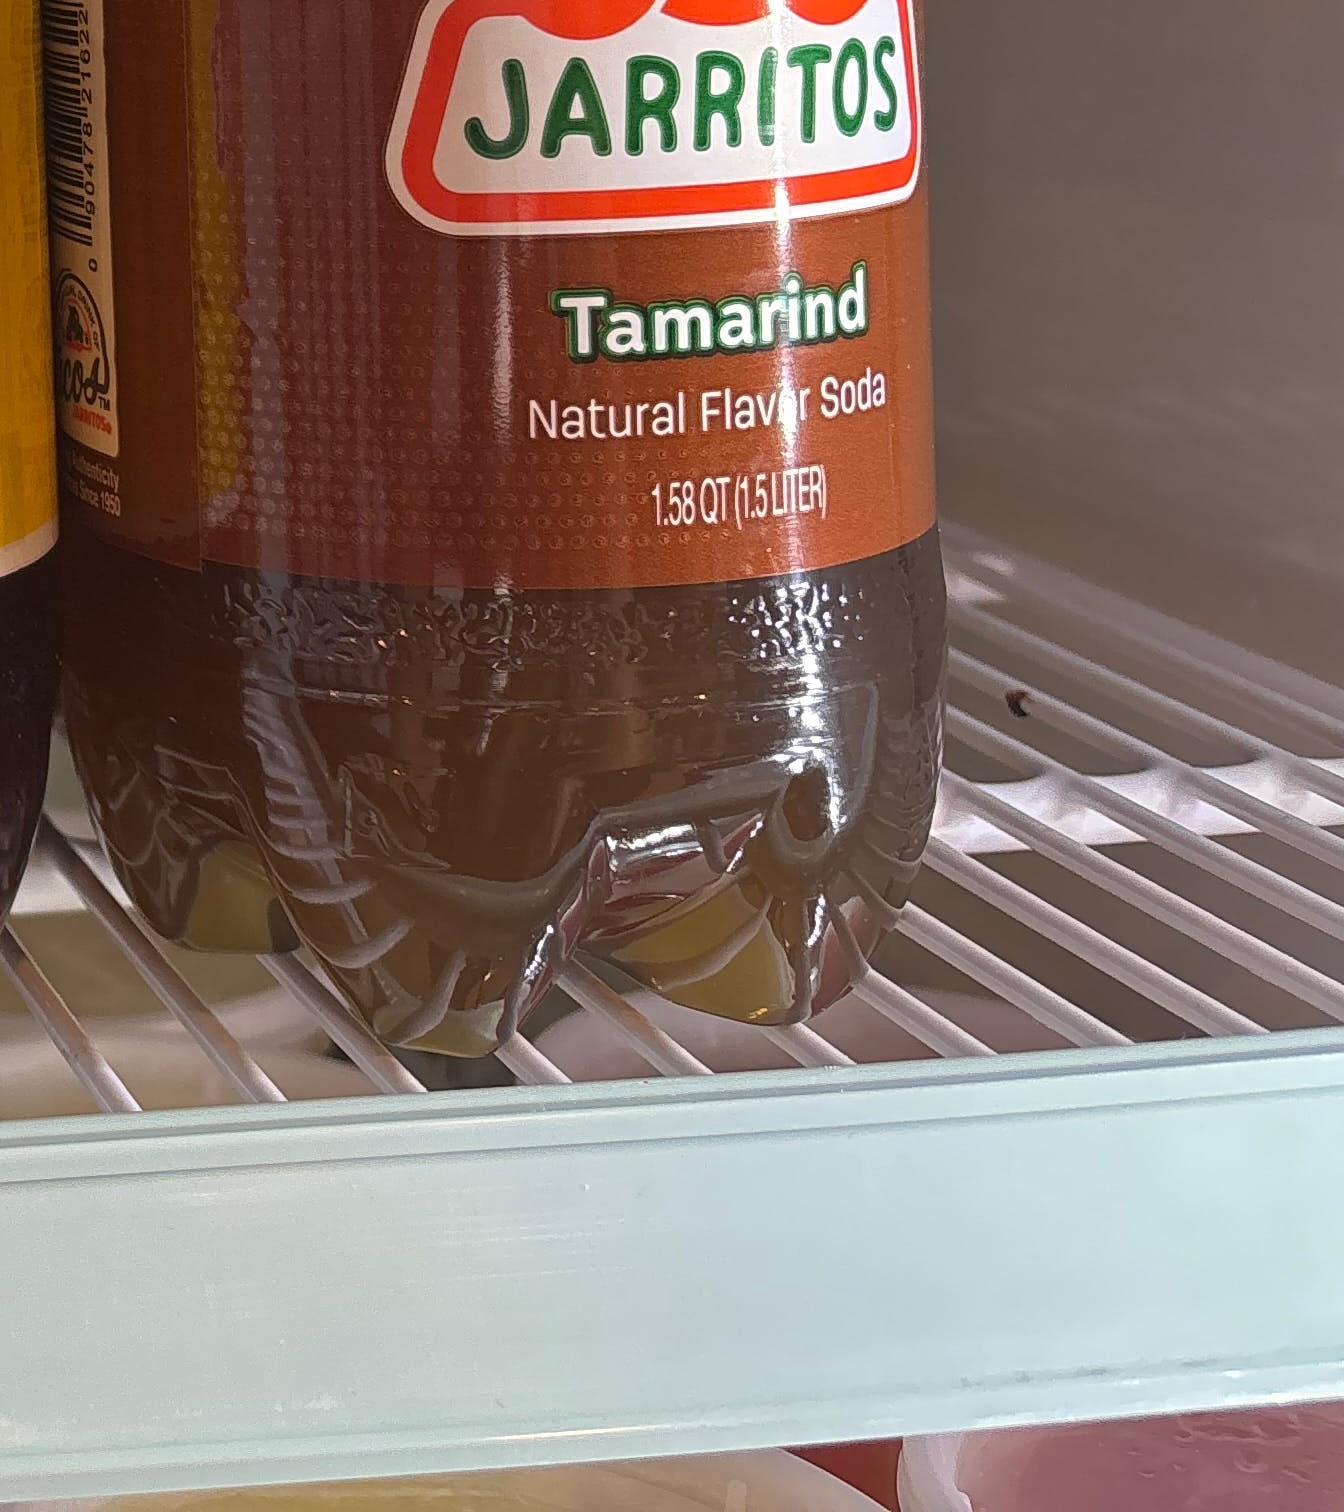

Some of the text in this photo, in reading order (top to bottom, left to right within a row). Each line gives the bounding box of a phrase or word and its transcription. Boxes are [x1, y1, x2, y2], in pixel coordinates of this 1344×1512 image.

[78, 9, 92, 105] 21622
[463, 36, 898, 159] JARRITOS
[81, 121, 96, 216] 90478
[551, 259, 868, 360] Tamarind
[528, 391, 686, 441] Natural
[820, 366, 886, 419] Soda
[100, 487, 120, 516] 1950
[652, 464, 826, 530] 1.58 QT (1.5 LITER)
